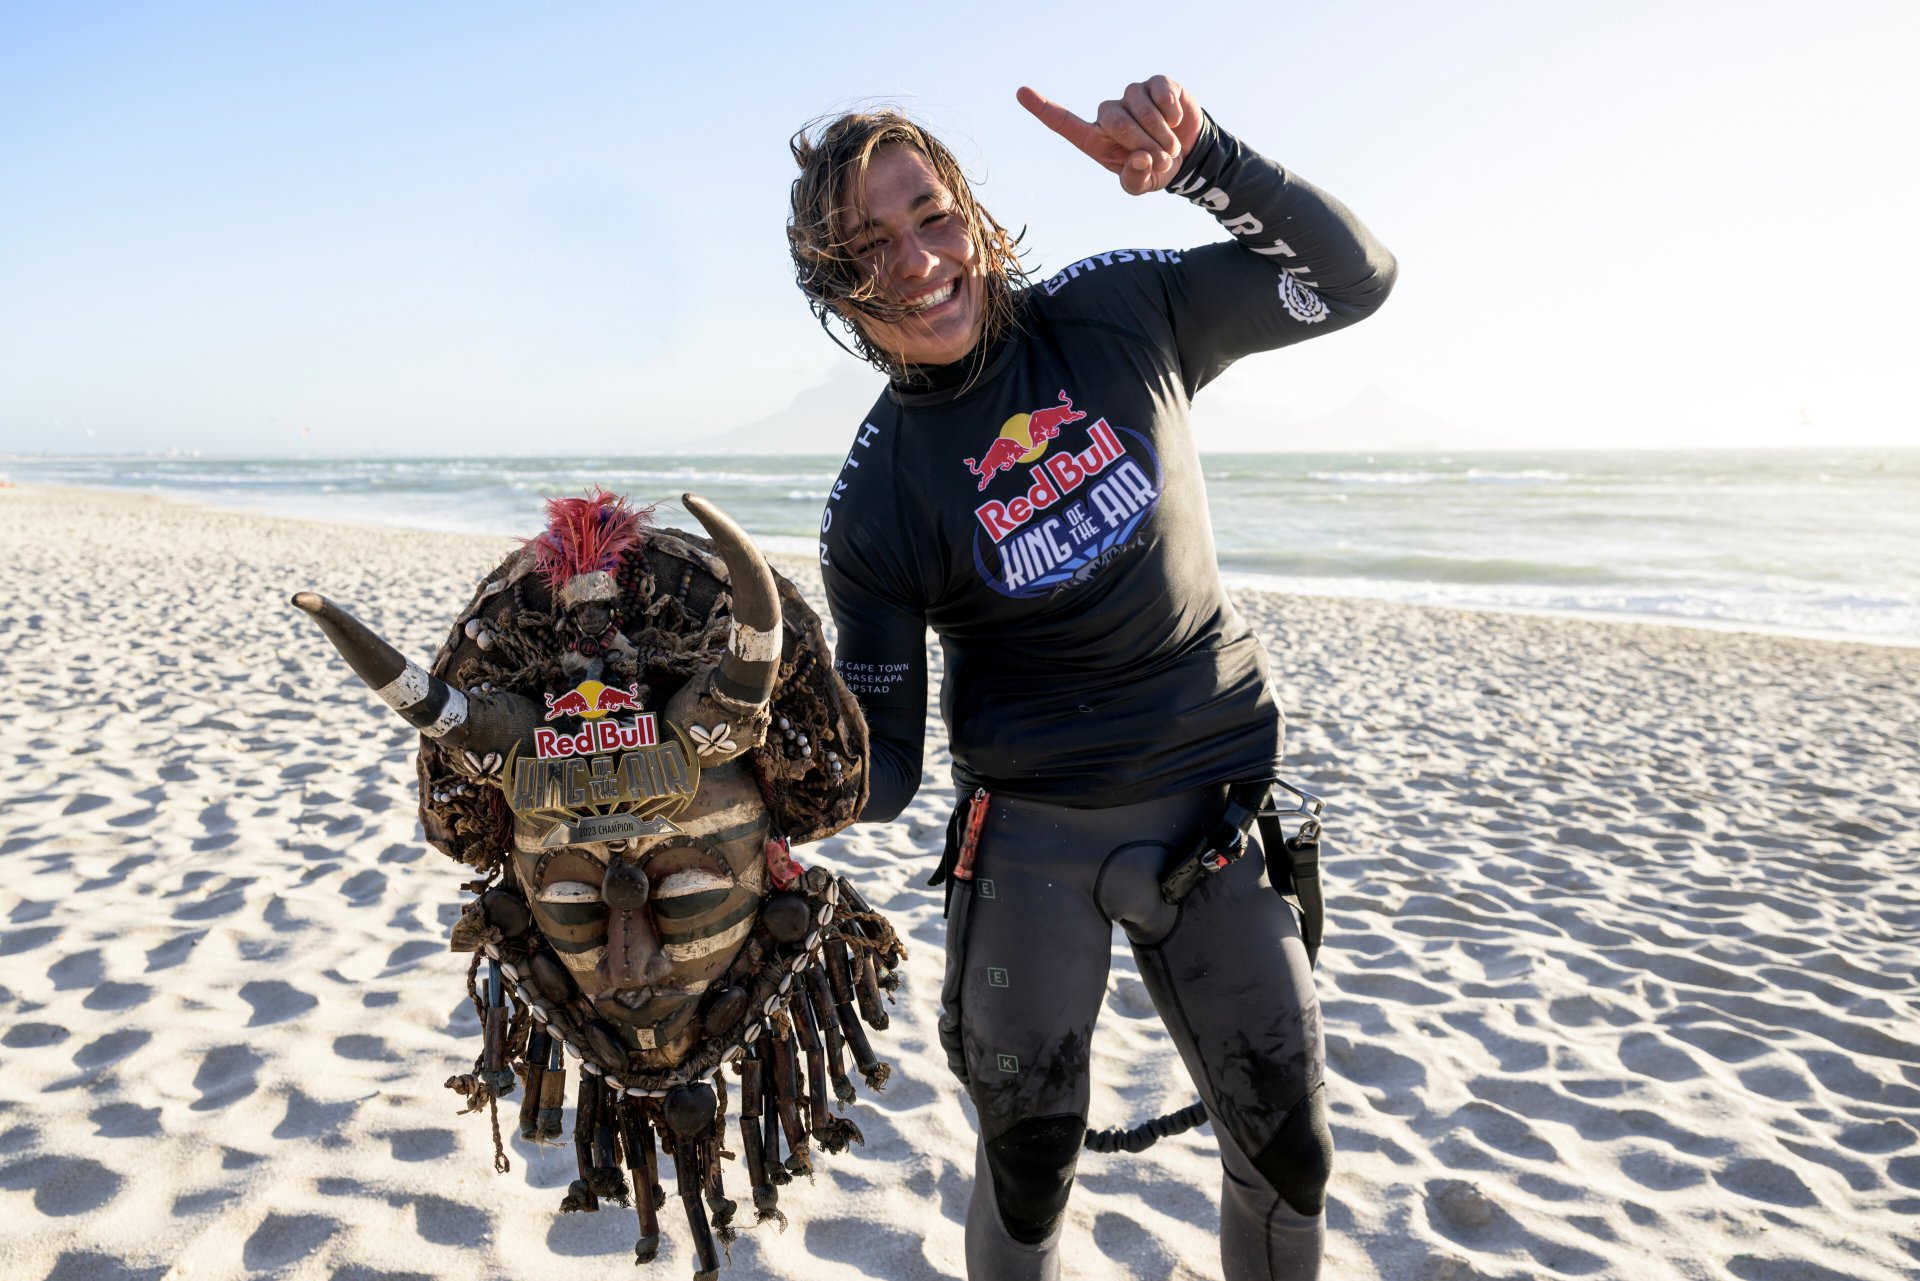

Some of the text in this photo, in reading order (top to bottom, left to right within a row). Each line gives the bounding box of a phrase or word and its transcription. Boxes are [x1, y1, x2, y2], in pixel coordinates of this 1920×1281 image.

[1066, 248, 1181, 279] MYSTIC
[820, 422, 880, 566] NORTH
[975, 417, 1126, 544] Red Bull
[1000, 461, 1157, 591] KING OF THE AIR
[846, 662, 874, 672] CAPE
[878, 663, 909, 673] TOWN
[846, 673, 903, 683] SASEKAPA
[846, 683, 890, 693] APSTAD
[534, 714, 657, 760] Red Bull
[513, 759, 586, 811] KING
[589, 778, 619, 800] THE
[625, 746, 695, 800] AIR
[579, 822, 634, 838] 2023 CHAMPION
